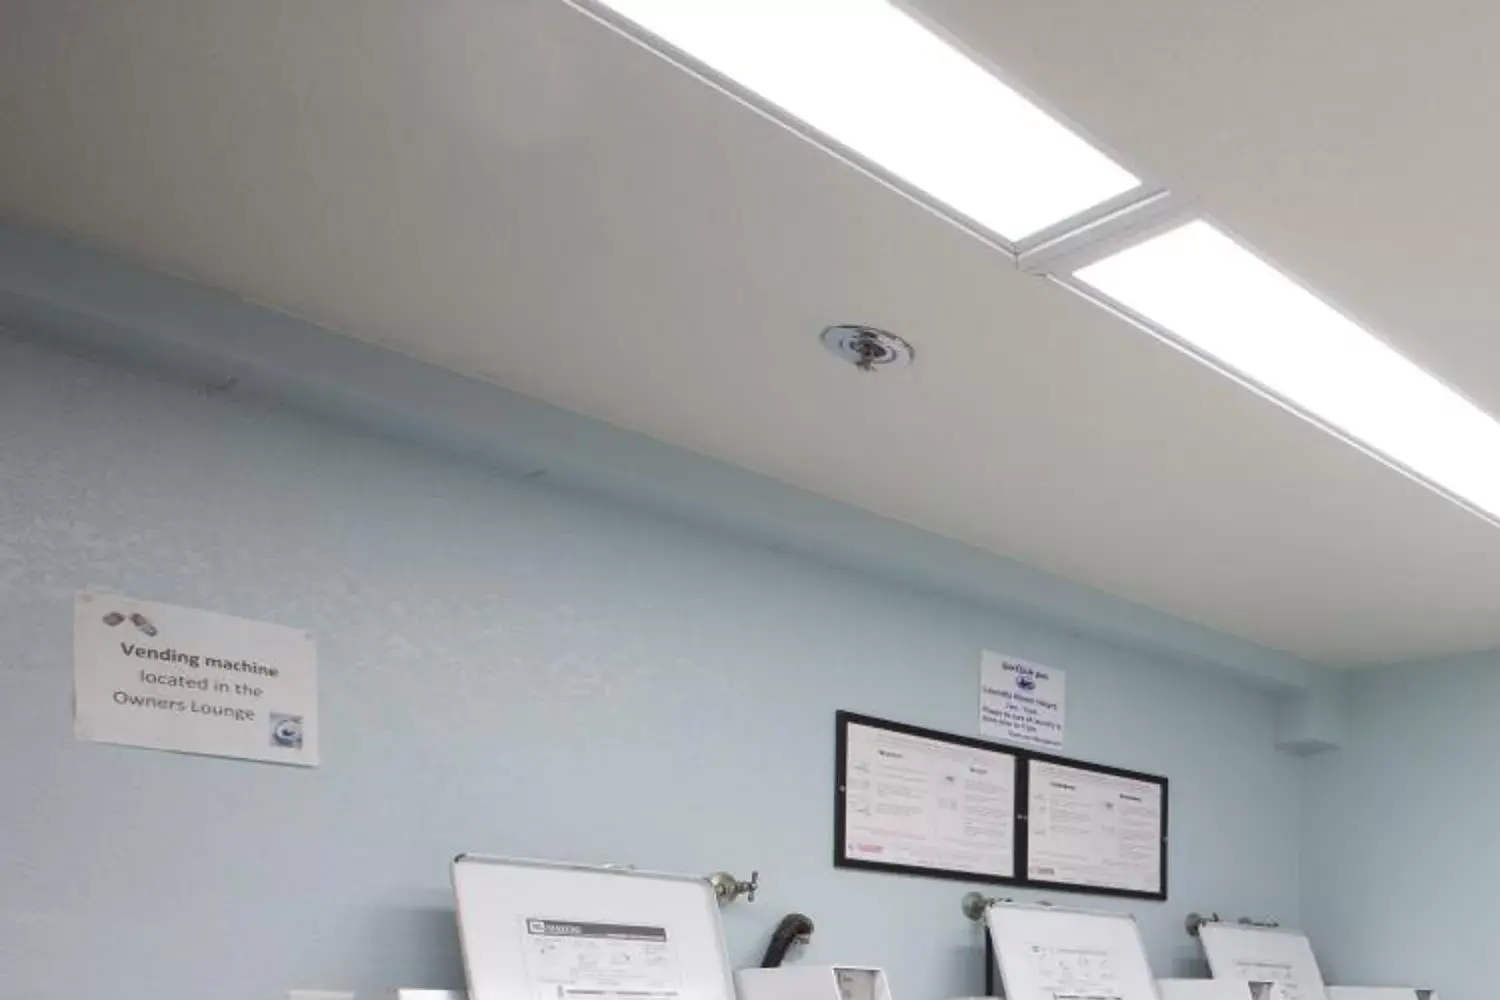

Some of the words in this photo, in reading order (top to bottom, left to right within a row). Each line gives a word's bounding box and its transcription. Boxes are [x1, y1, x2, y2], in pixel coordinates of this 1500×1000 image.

[120, 642, 200, 668] Vending
[205, 655, 279, 678] machine
[140, 669, 209, 691] located
[213, 681, 229, 693] in
[235, 683, 264, 698] the
[113, 690, 186, 712] Owners
[190, 701, 255, 721] Lounge
